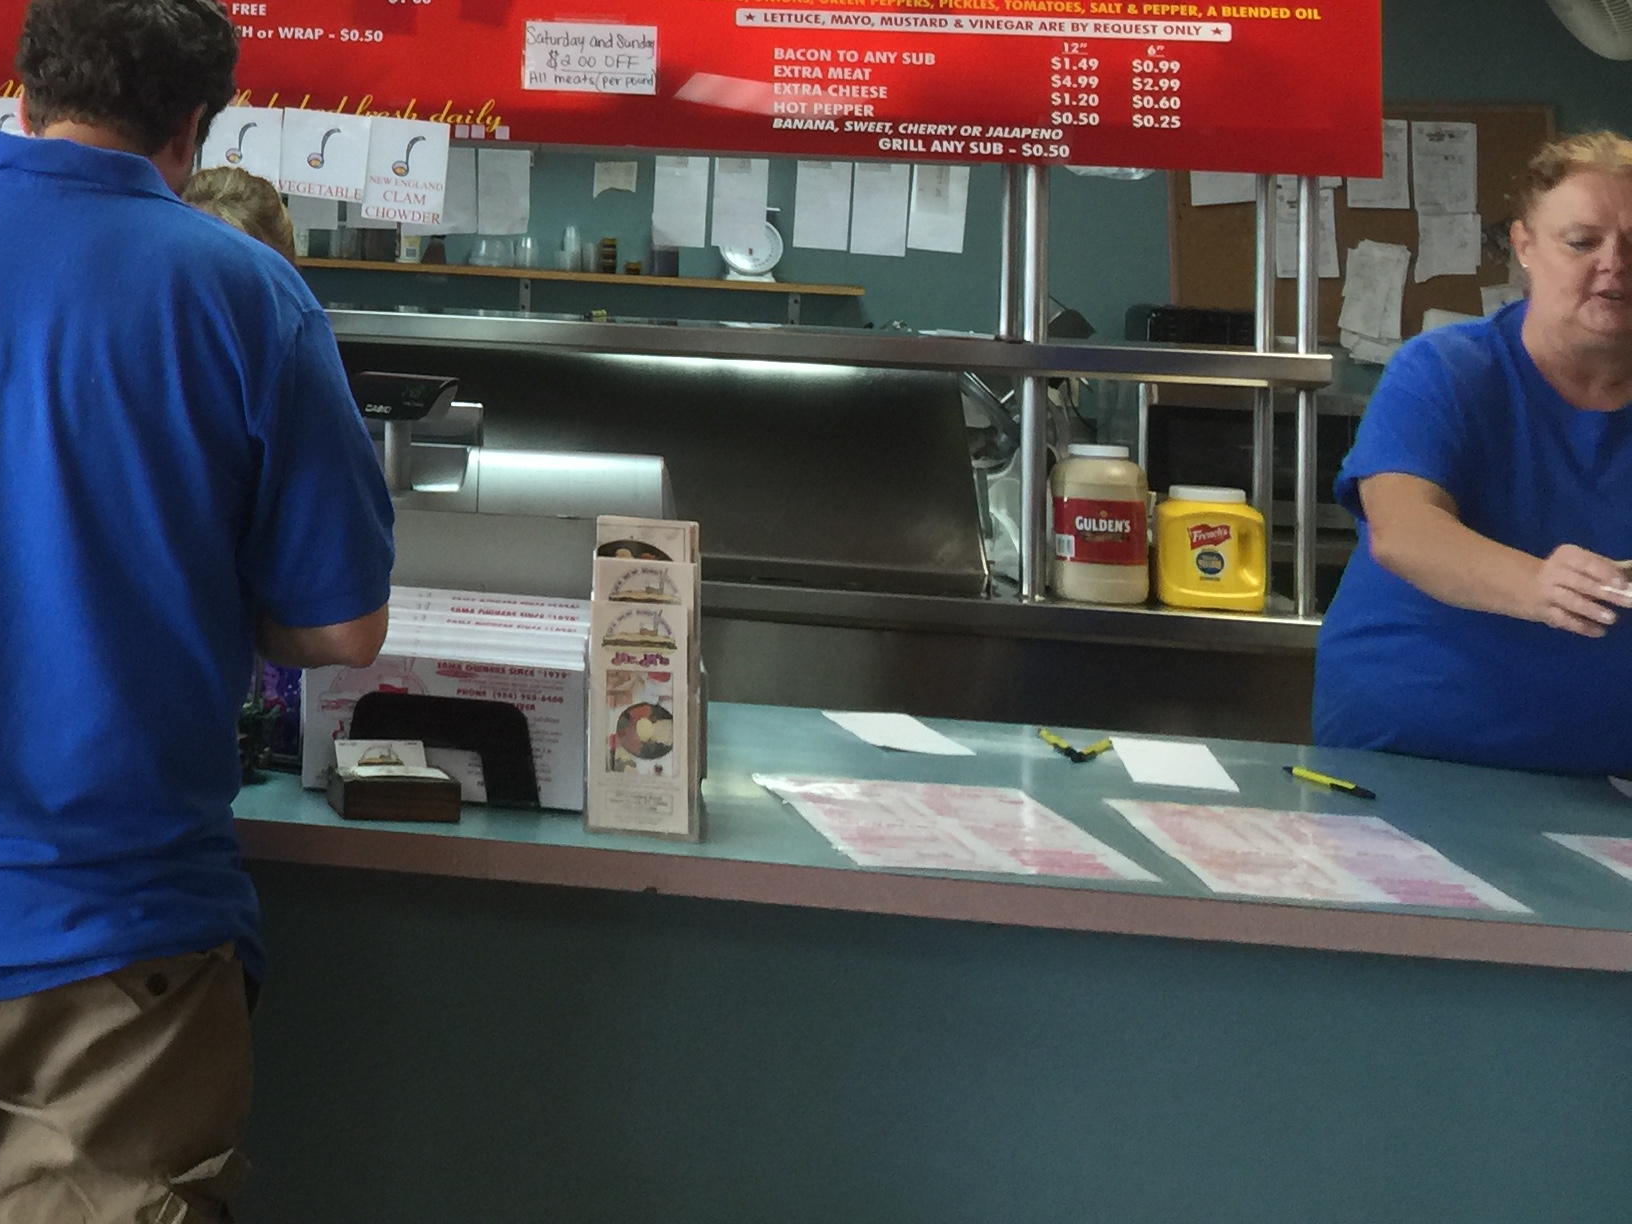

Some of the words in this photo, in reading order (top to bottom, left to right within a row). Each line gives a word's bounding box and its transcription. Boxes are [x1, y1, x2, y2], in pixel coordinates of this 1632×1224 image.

[232, 3, 266, 15] FREE
[764, 12, 824, 27] LETTUCE,
[831, 14, 874, 29] MAYO,
[880, 16, 948, 31] MUSTARD
[954, 19, 963, 31] &
[969, 19, 1033, 33] VINEGAR
[1038, 21, 1064, 34] ARE
[1071, 22, 1088, 35] BY
[1094, 23, 1157, 37] REQUEST
[1163, 25, 1201, 39] ONLY
[527, 26, 586, 53] Saturday
[590, 33, 614, 49] and
[617, 33, 655, 60] Sunday
[604, 55, 640, 69] OFF
[529, 71, 547, 85] All
[554, 73, 595, 87] meats
[430, 99, 502, 133] daily
[878, 137, 925, 151] GRILL
[930, 140, 964, 152] ANY
[969, 141, 1003, 154] SUB
[1022, 143, 1069, 157] $0.50
[278, 179, 362, 201] VEGETABLE
[369, 176, 391, 186] NEW
[394, 178, 444, 192] ENGLAND
[383, 191, 426, 206] CLAM
[365, 207, 441, 225] CHOWDER
[1075, 515, 1131, 533] GULDEN'S
